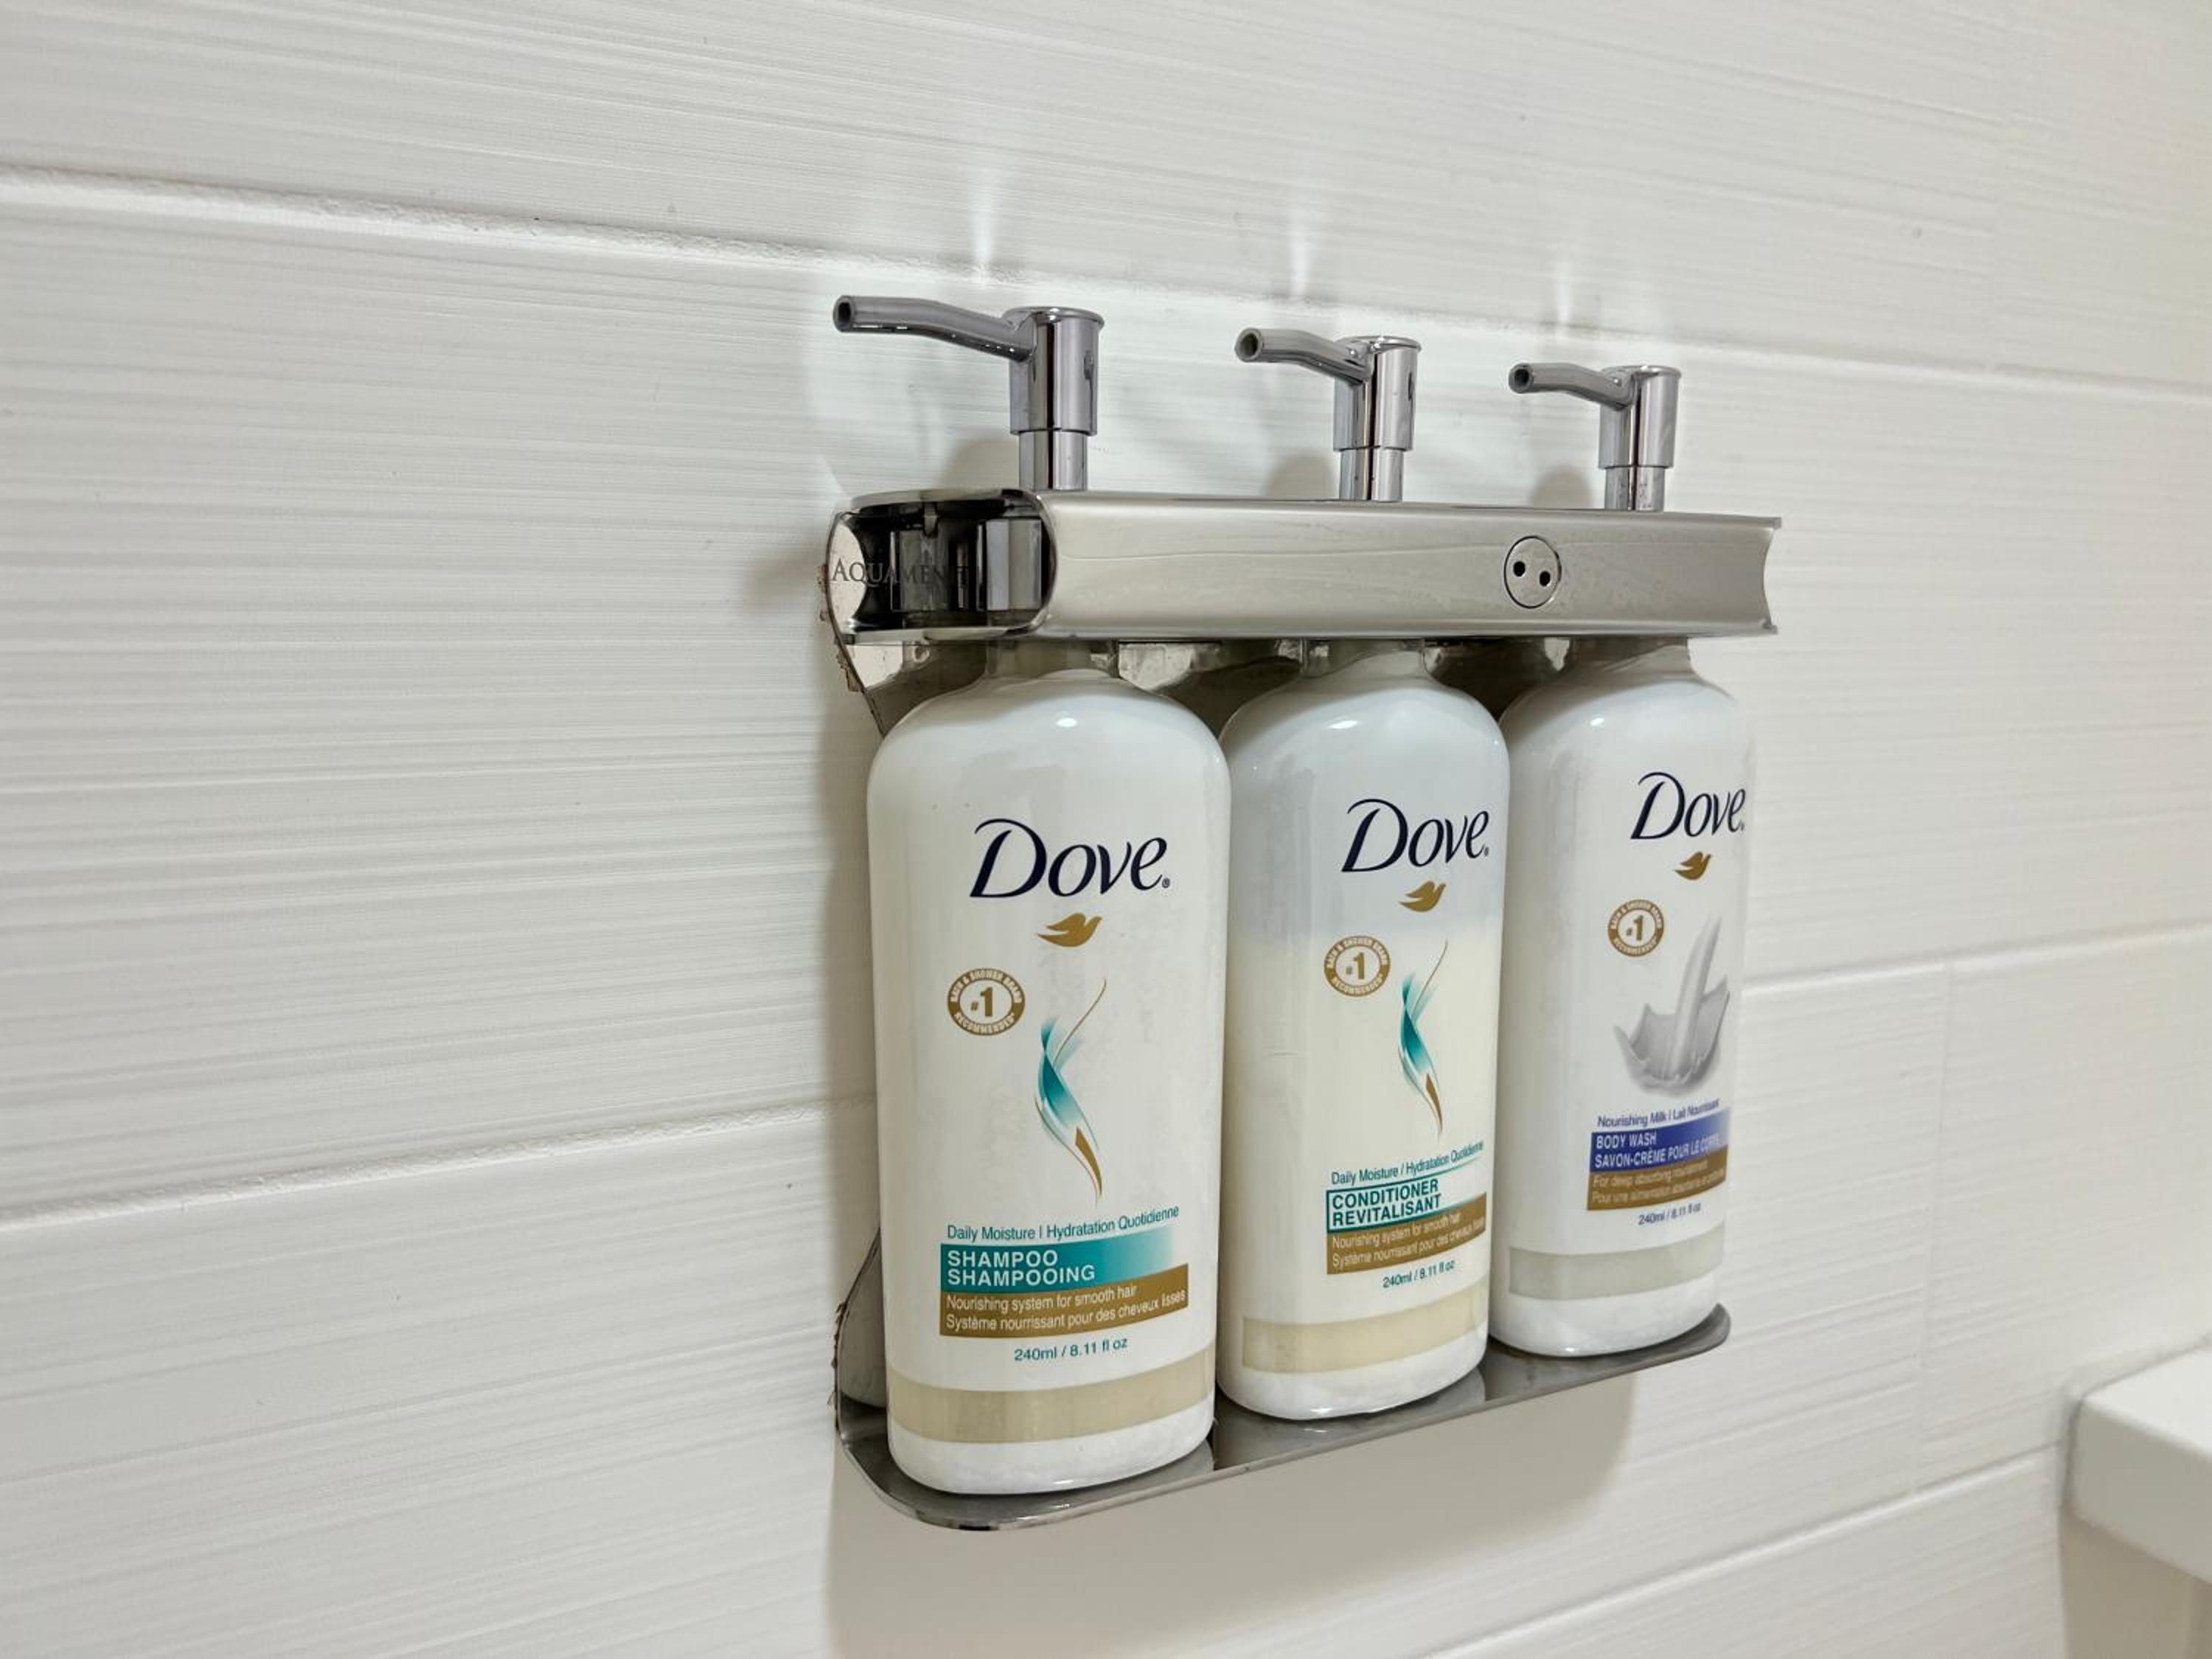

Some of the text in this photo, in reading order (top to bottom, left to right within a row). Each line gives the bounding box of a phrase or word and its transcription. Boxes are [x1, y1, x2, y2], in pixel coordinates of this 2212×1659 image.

[1630, 771, 1745, 839] Dove
[1340, 799, 1489, 872] Dove
[970, 818, 1168, 897] Dove
[1597, 1114, 1647, 1127] Nourishing
[1595, 1148, 1666, 1169] SAVON-CRÈME
[1667, 1143, 1689, 1160] POUR
[1691, 1138, 1700, 1155] LE
[1596, 1132, 1657, 1149] BODY WASH
[1332, 1172, 1355, 1186] Daily
[1360, 1167, 1398, 1181] Moisture
[1406, 1154, 1450, 1175] Hydratation
[1332, 1178, 1439, 1210] CONDITIONER
[1332, 1193, 1441, 1226] REVITALISANT
[947, 1225, 977, 1242] Daily
[981, 1226, 1035, 1240] Moisture
[1047, 1222, 1115, 1241] Hydratation
[1119, 1206, 1179, 1230] Quotidienne
[1638, 1211, 1666, 1225] 240ml
[947, 1250, 1057, 1267] SHAMPOO
[947, 1265, 1095, 1287] SHAMPOOING
[1382, 1272, 1412, 1288] 240ml
[1419, 1264, 1437, 1279] 8.11
[947, 1284, 1137, 1314] Nourishing system for smooth hair
[946, 1314, 997, 1332] Système
[1068, 1312, 1093, 1329] pour
[1096, 1307, 1116, 1321] des
[1119, 1300, 1159, 1318] cheveux
[1014, 1346, 1057, 1361] 240ml
[1070, 1341, 1097, 1356] 8.11
[1102, 1338, 1110, 1352] fl
[1113, 1338, 1127, 1350] oz
